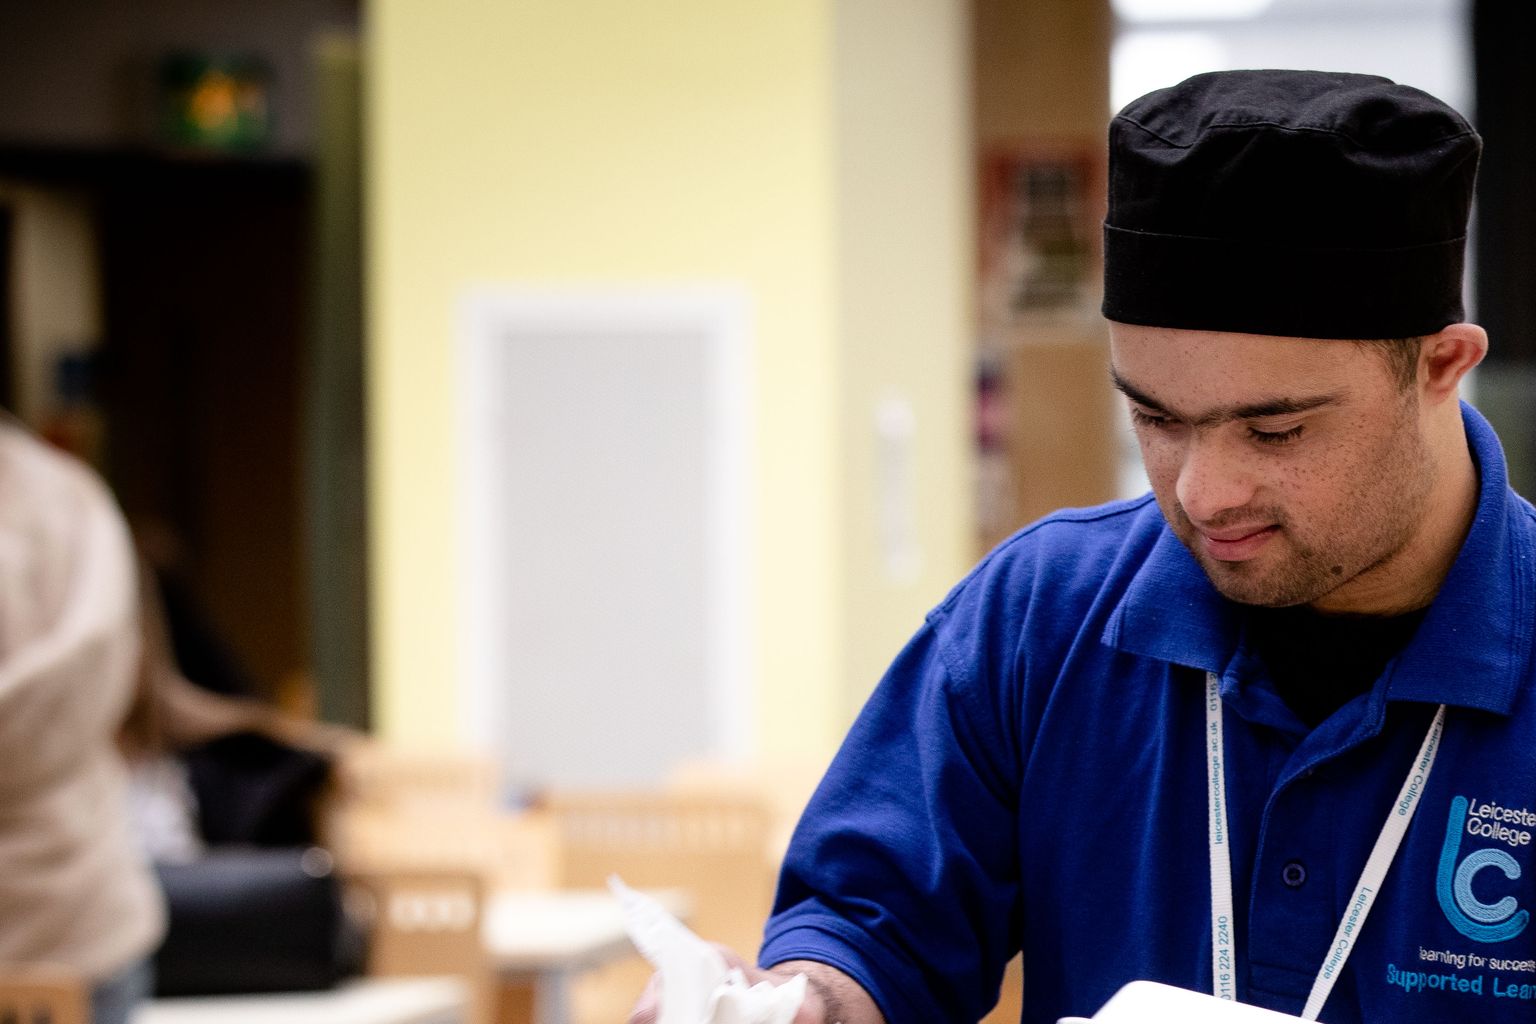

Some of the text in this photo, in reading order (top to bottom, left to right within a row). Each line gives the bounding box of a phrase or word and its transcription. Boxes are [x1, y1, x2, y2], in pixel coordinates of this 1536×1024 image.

[1398, 774, 1424, 816] College
[1466, 817, 1532, 847] College
[1217, 915, 1229, 945] 2240
[1323, 886, 1373, 980] Leicester College
[1218, 949, 1231, 970] 224
[1468, 952, 1488, 968] for
[1386, 963, 1484, 993] Supported
